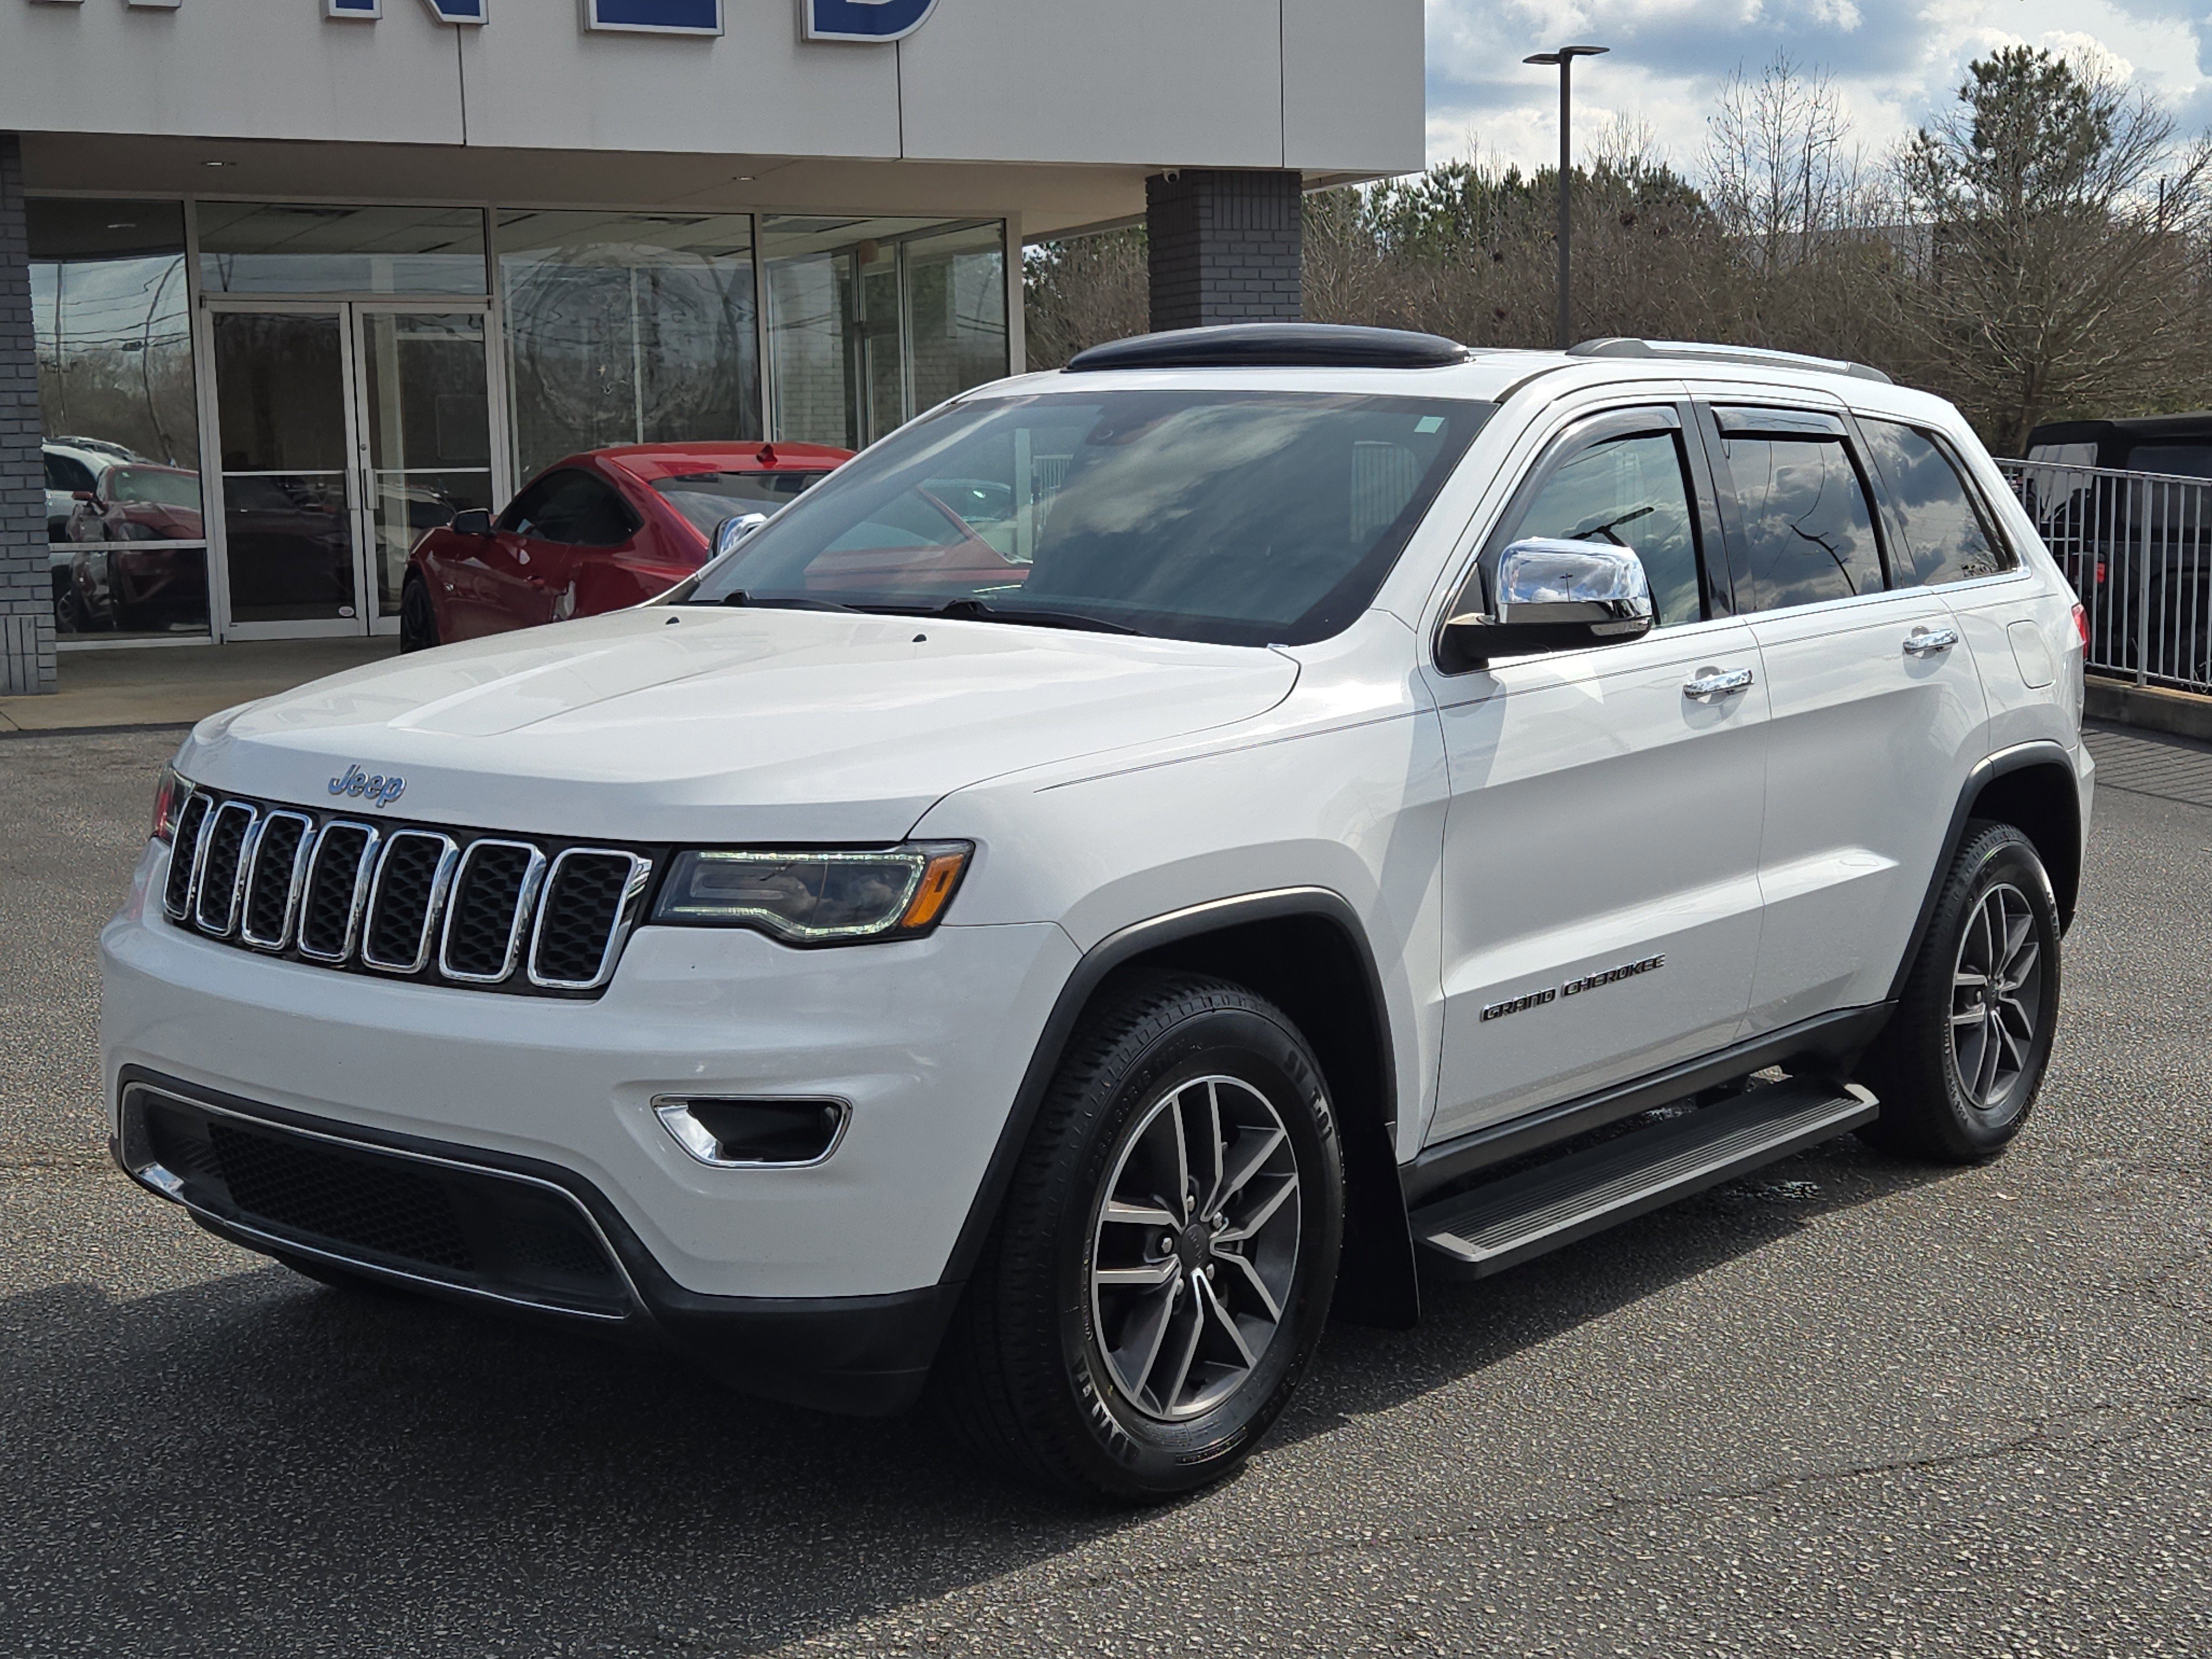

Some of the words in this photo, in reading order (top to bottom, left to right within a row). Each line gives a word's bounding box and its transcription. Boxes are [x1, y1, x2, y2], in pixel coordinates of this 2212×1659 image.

[328, 764, 407, 808] Jeep
[1480, 987, 1556, 1022] GRAND
[1561, 953, 1666, 998] CHEROKEE
